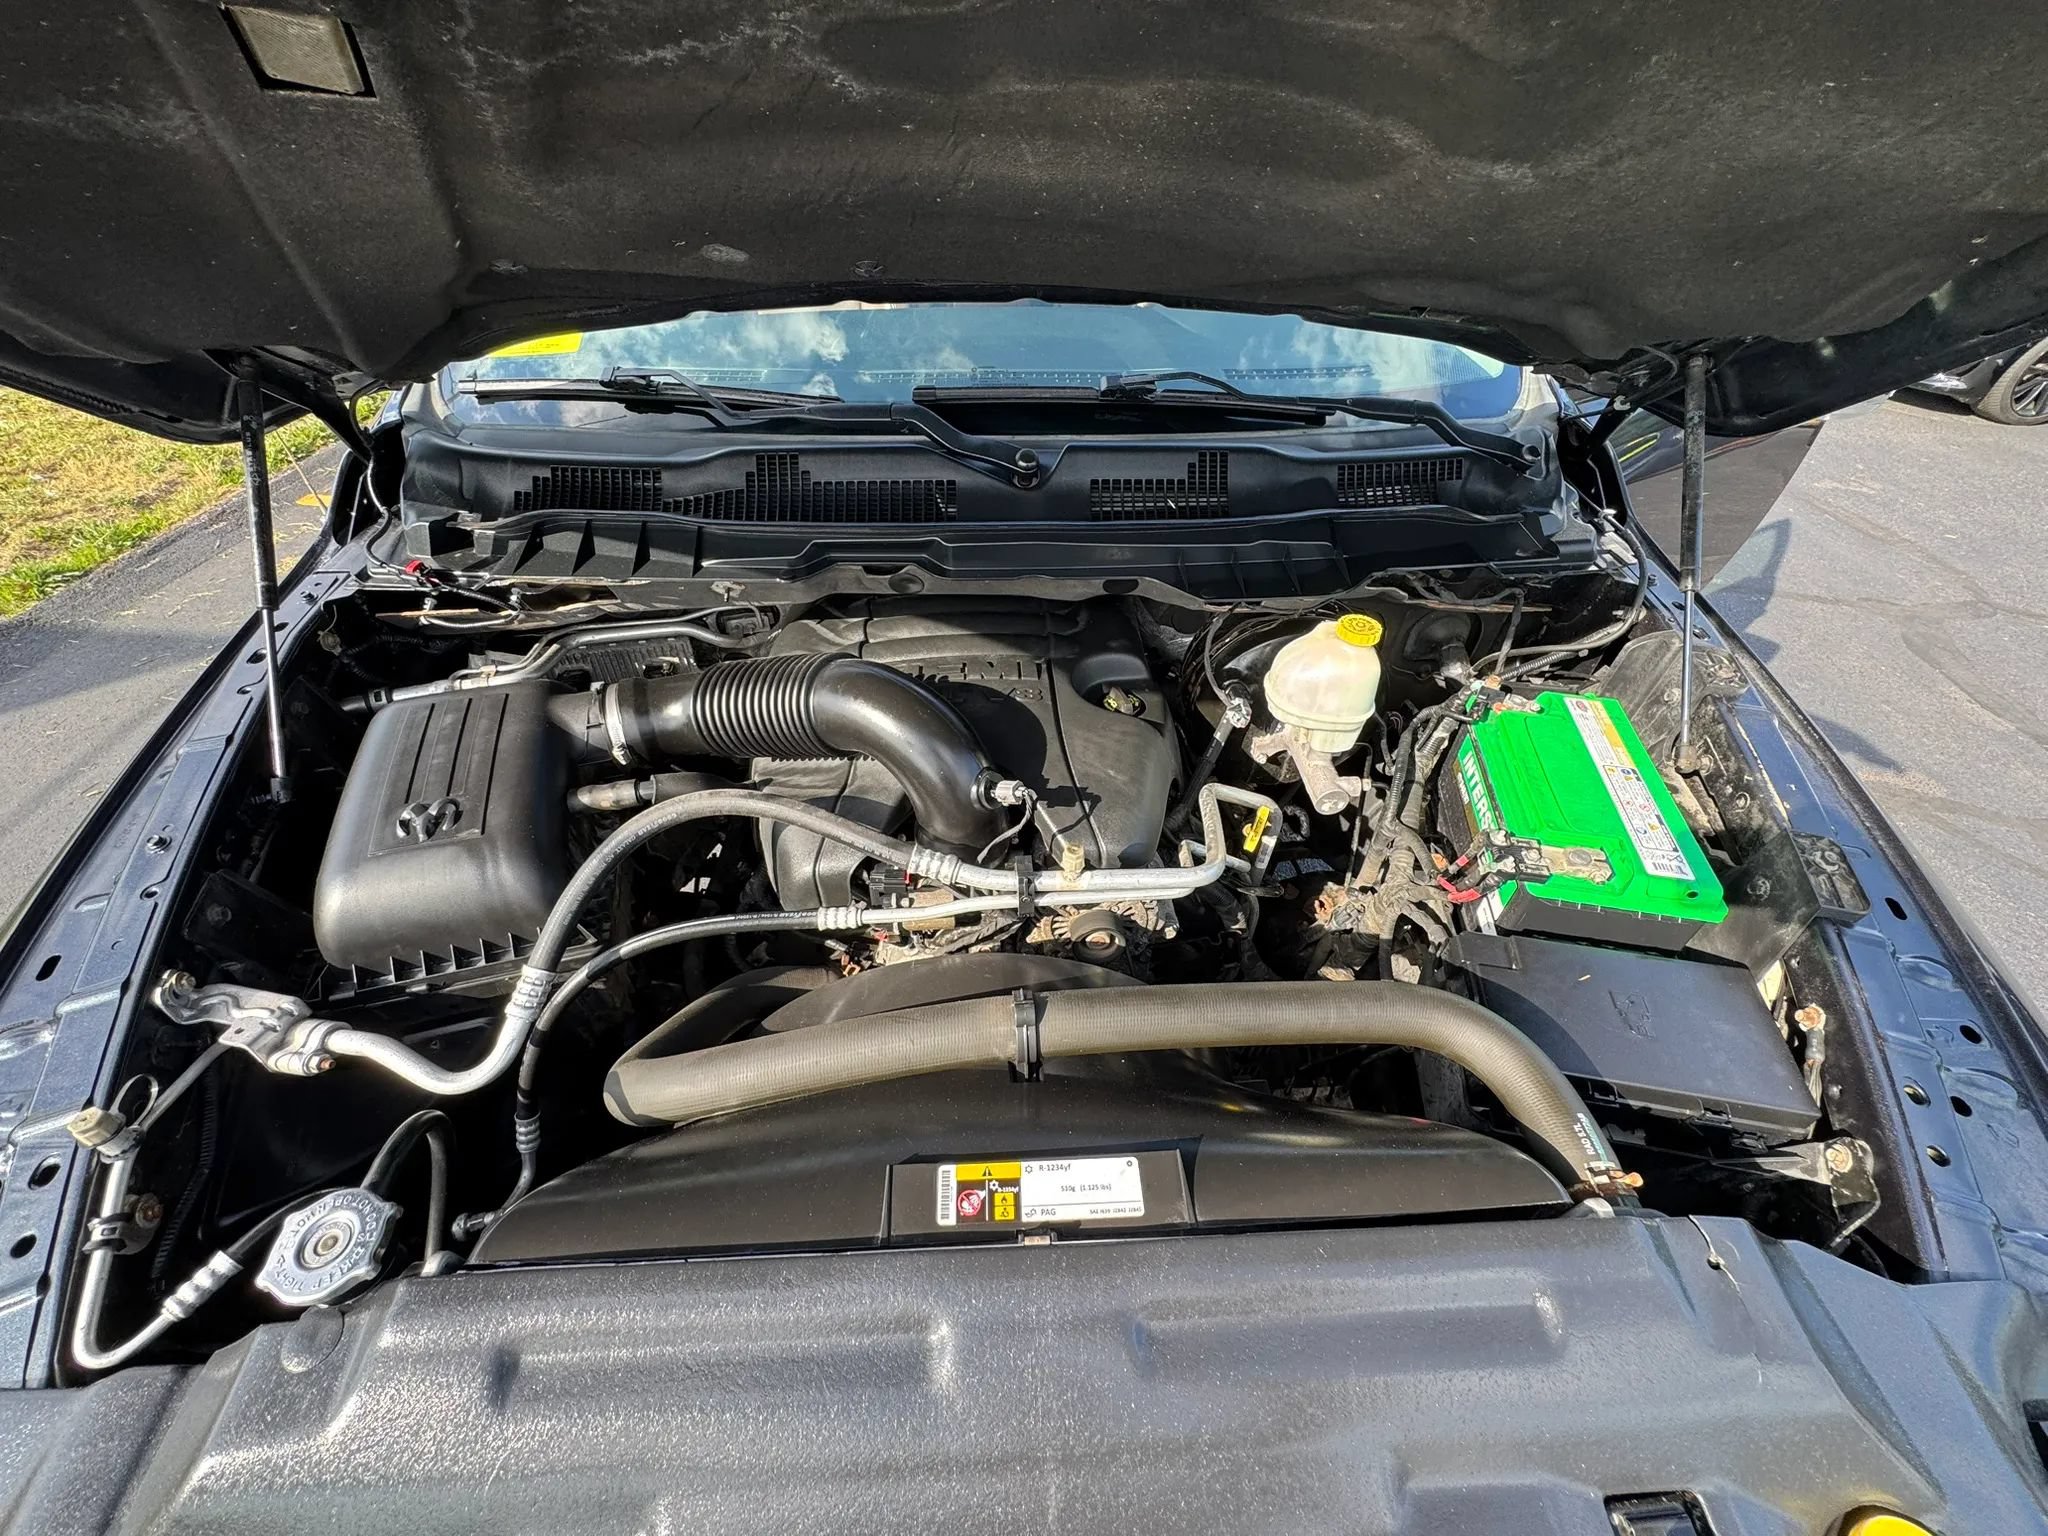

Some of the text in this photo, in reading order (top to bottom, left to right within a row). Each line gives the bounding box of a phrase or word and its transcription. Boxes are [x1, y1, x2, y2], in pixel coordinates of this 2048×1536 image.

[1581, 1138, 1596, 1155] RAD
[1039, 1163, 1071, 1172] R-1234yf
[1041, 1208, 1056, 1216] PAG
